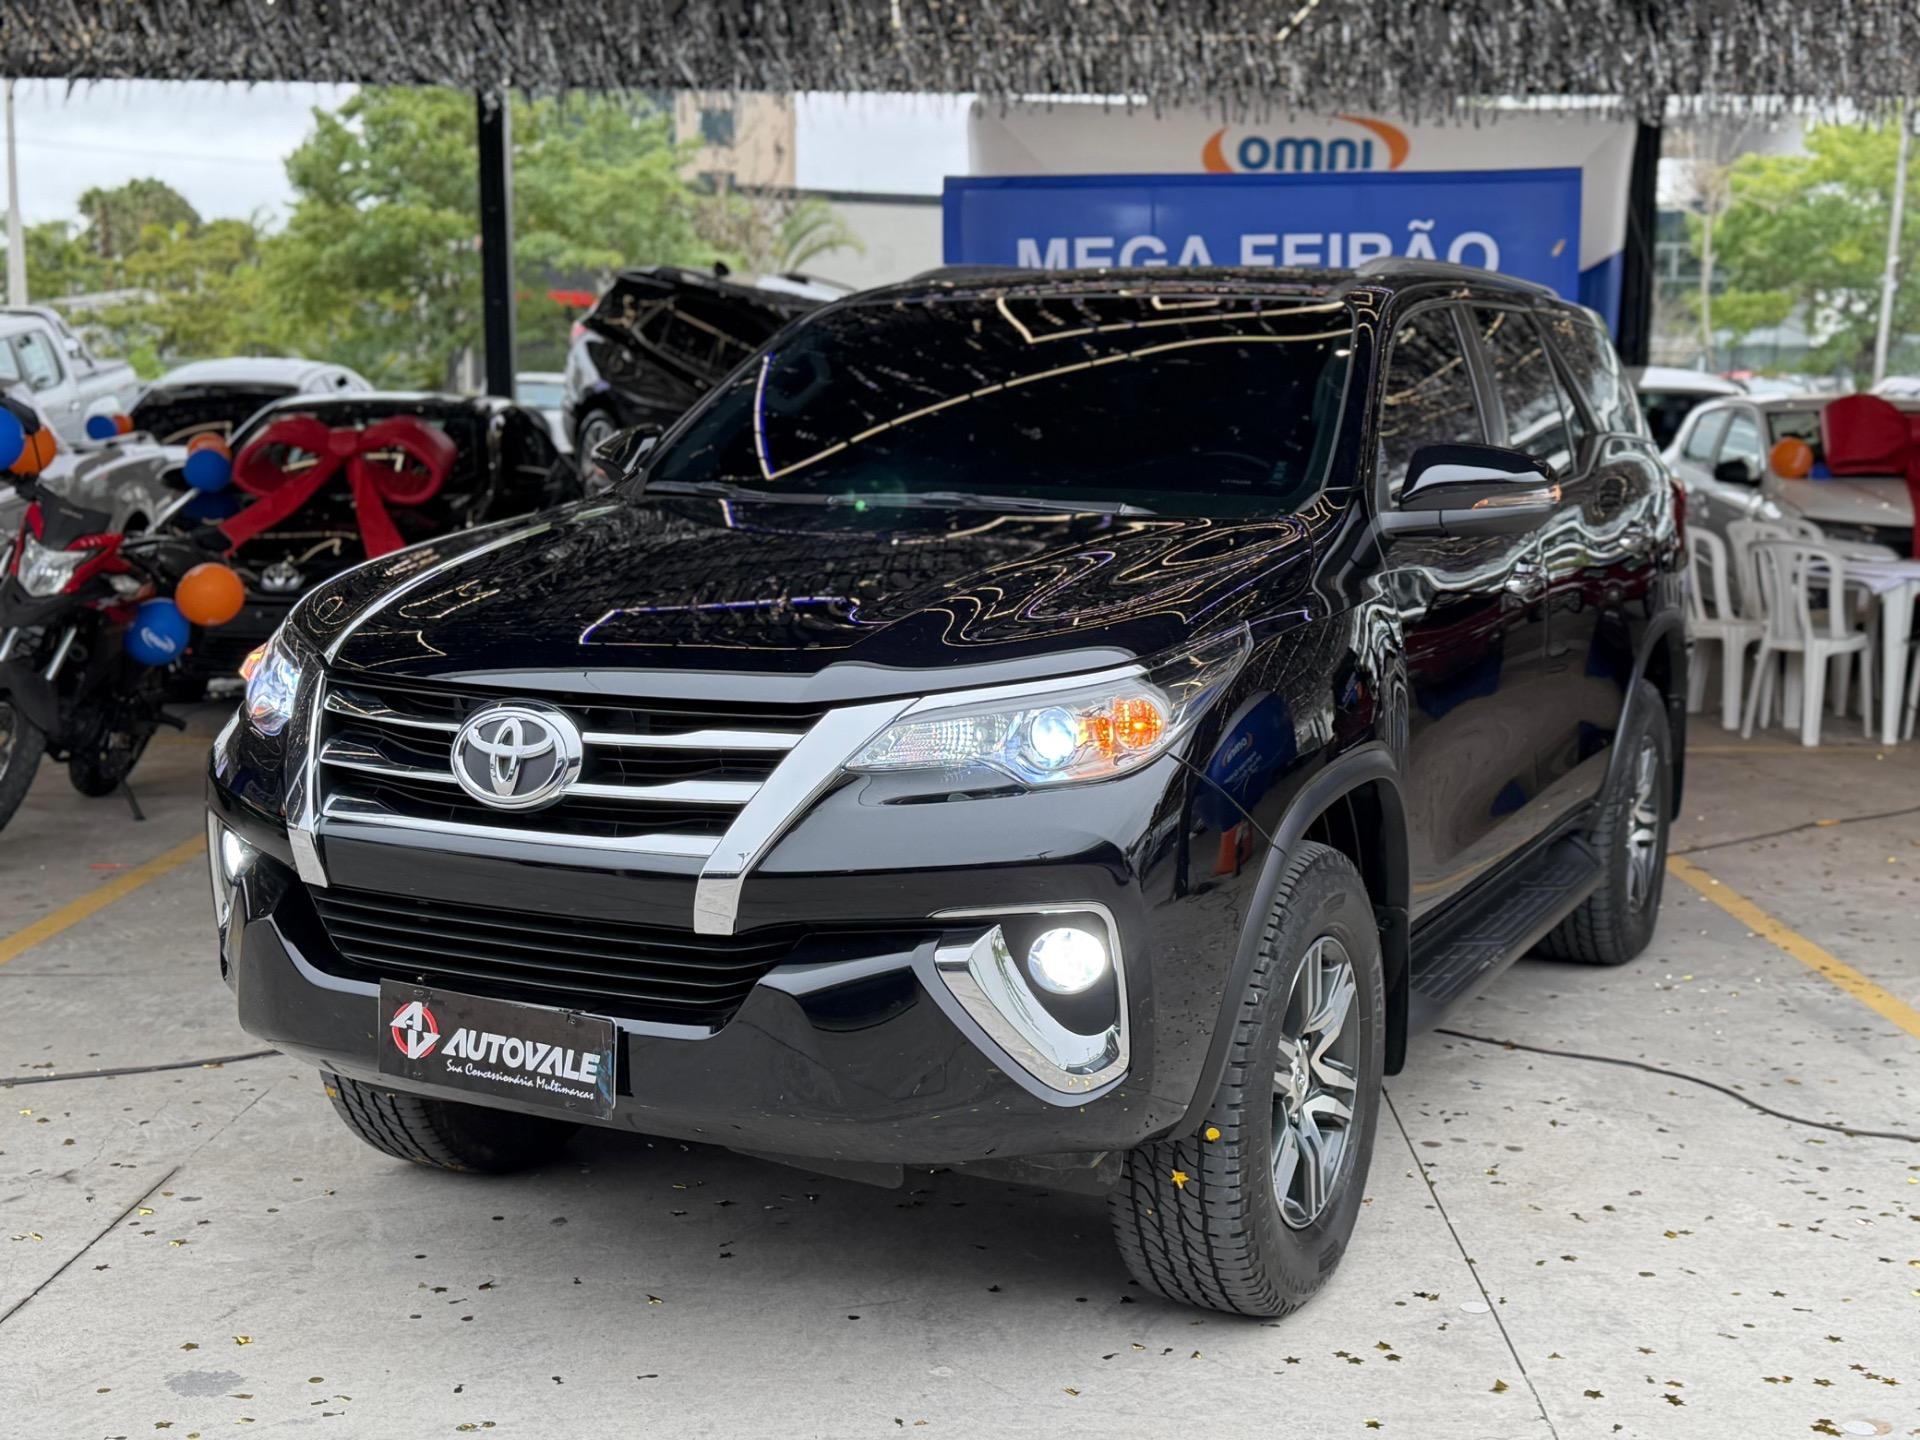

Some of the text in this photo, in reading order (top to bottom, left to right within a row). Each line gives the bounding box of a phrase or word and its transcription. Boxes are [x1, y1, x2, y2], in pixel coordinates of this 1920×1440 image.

[1238, 136, 1374, 171] omni
[441, 1028, 600, 1084] AUTOVALE
[446, 1059, 463, 1073] Sua
[535, 1075, 595, 1100] Multimarcas
